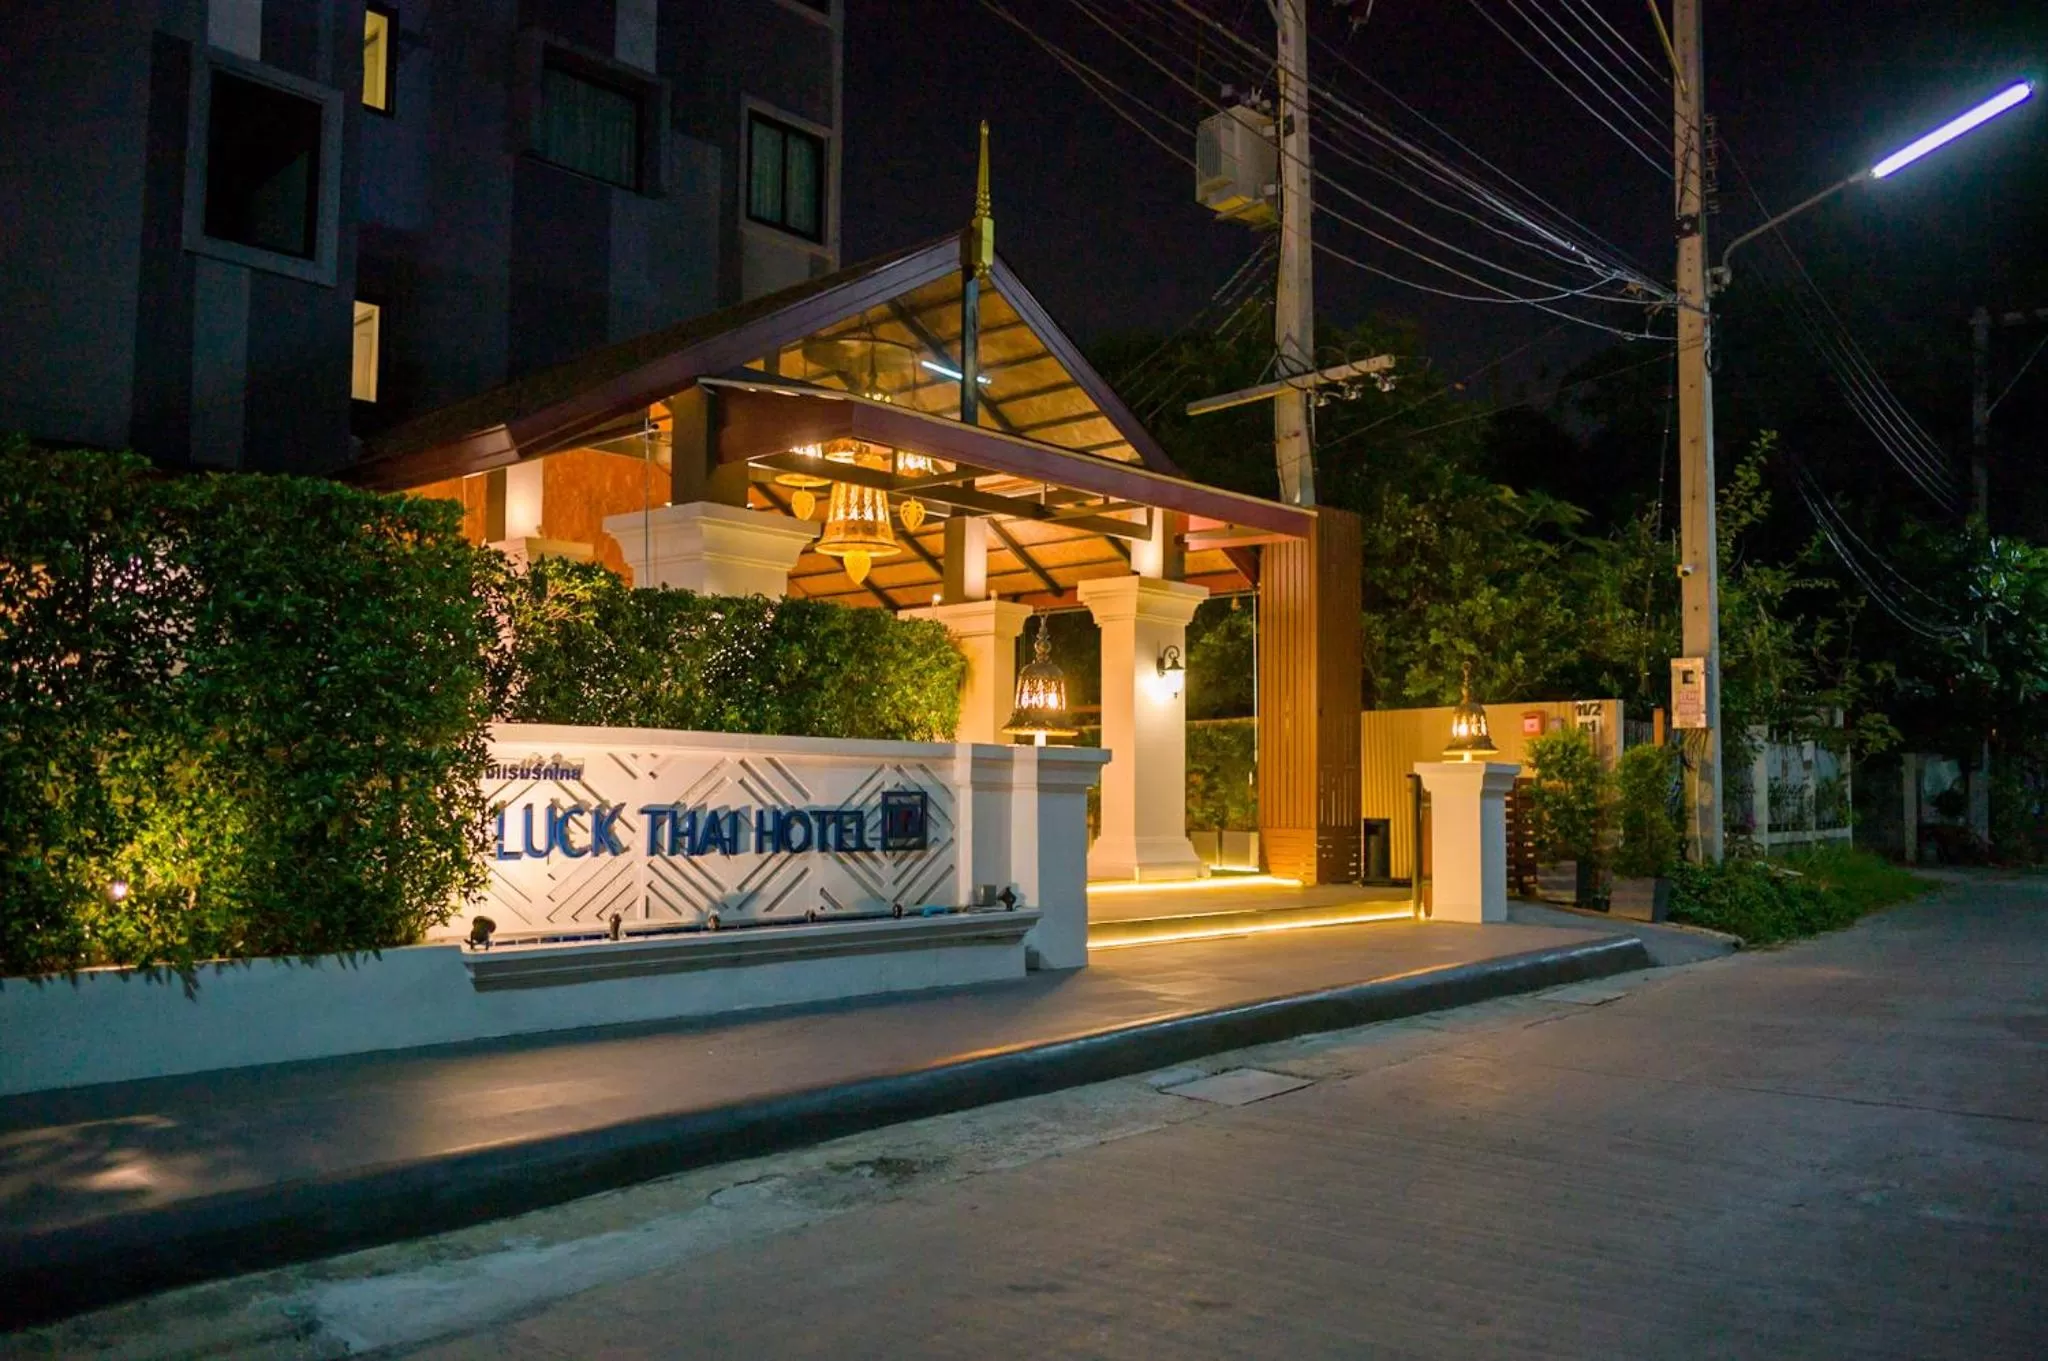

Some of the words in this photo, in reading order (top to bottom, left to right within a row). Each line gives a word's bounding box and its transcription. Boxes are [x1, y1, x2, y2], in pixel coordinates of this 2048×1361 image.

[498, 803, 626, 859] LUCK
[638, 806, 738, 856] THAI
[755, 808, 874, 856] HOTEL
